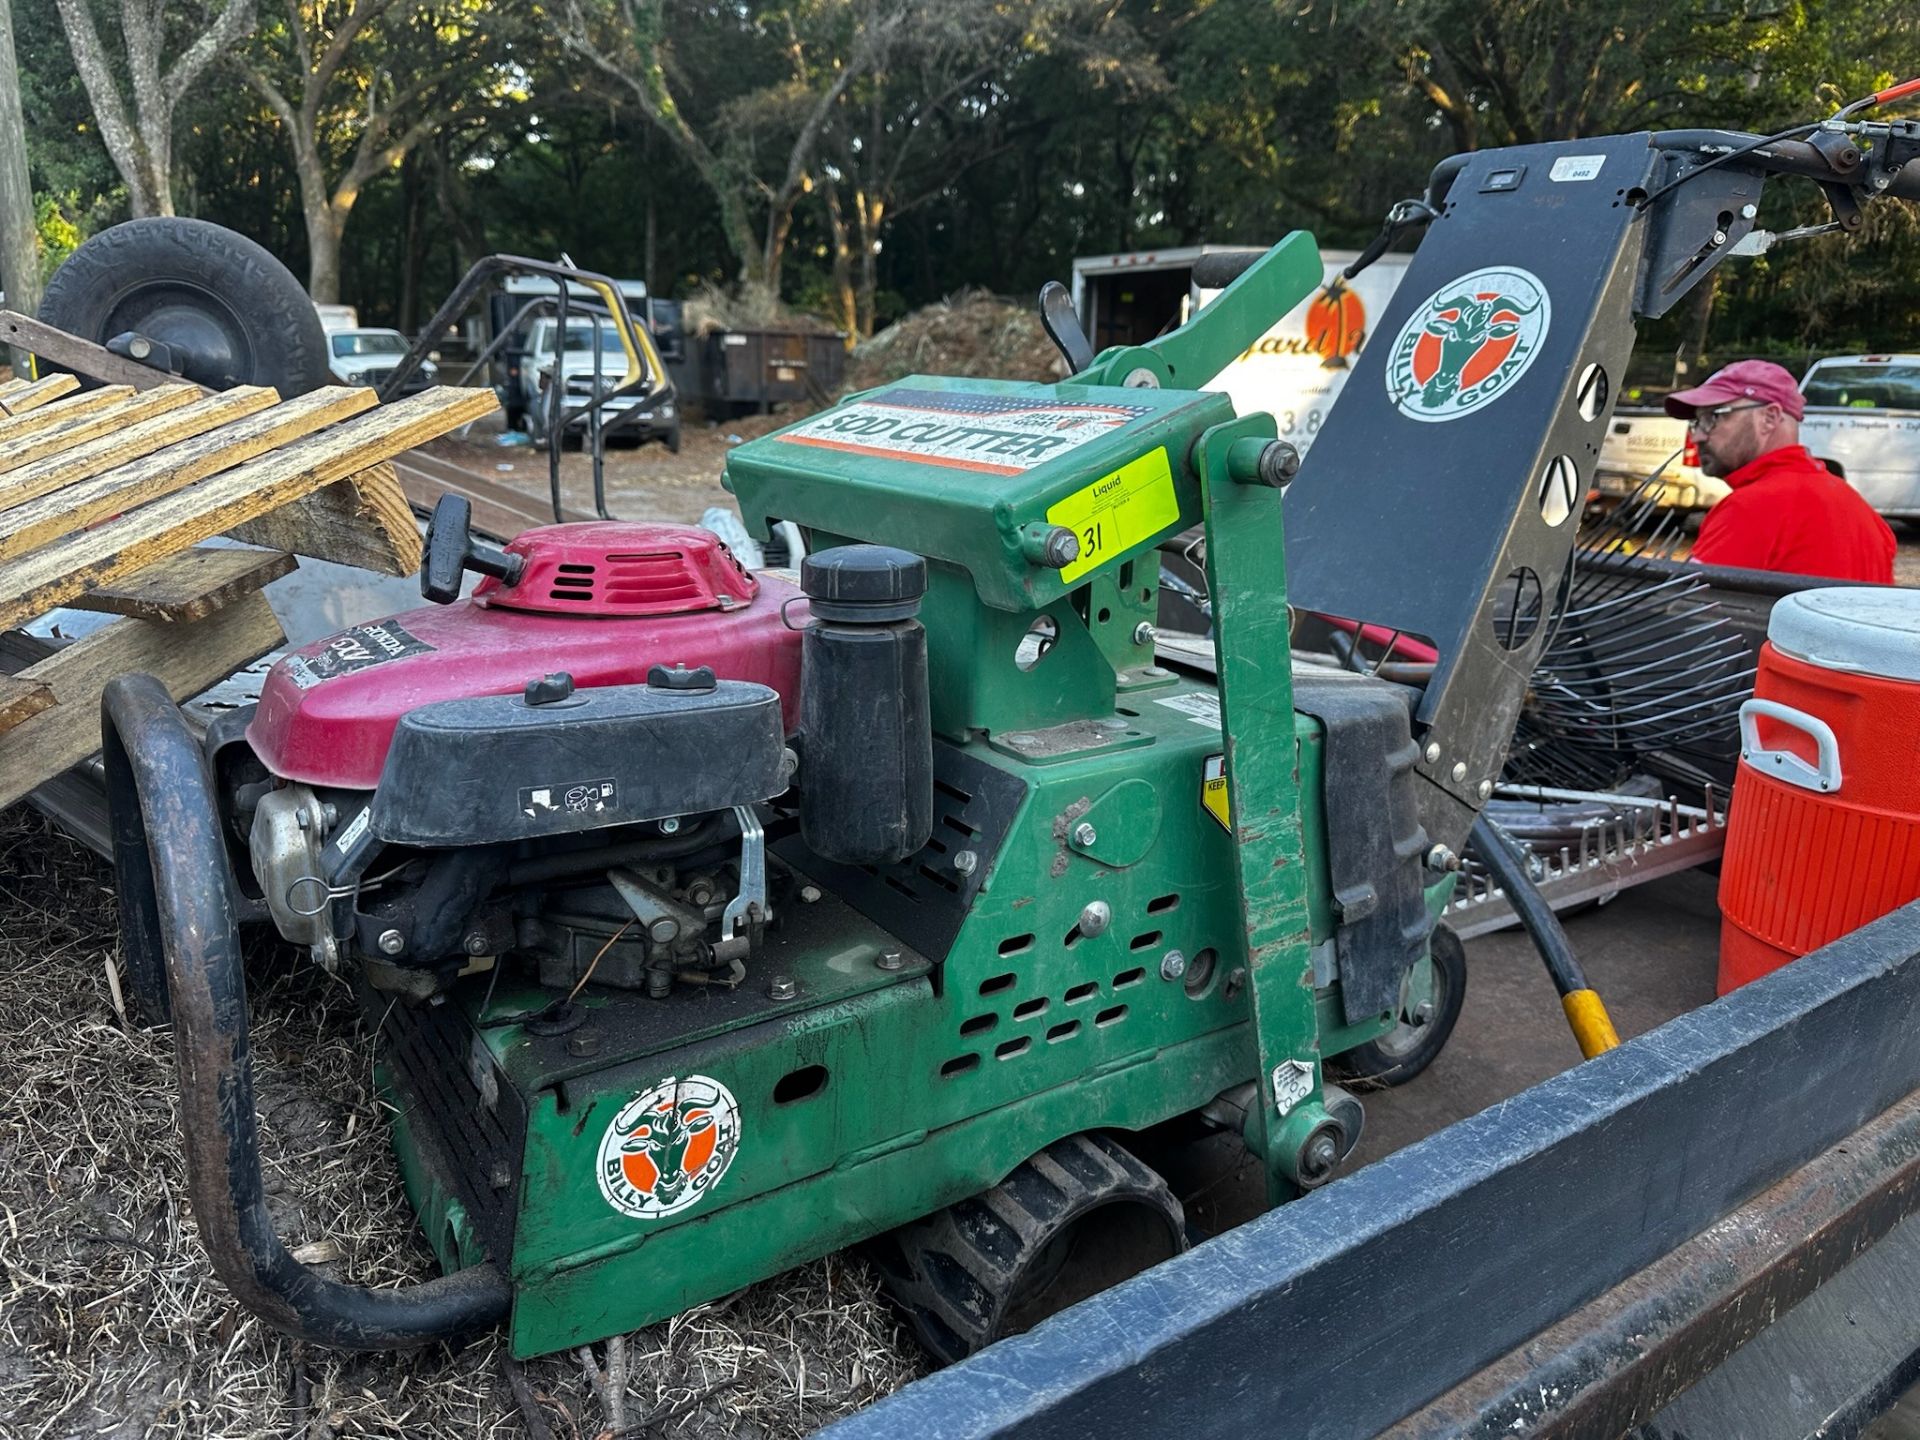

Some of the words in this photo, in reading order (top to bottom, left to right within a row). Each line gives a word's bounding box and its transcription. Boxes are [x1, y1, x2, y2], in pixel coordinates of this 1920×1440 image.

[1396, 332, 1422, 400] BILLY
[1456, 341, 1531, 407] GOAT
[816, 413, 901, 436] SOD
[889, 422, 1067, 459] CUTTER
[1092, 474, 1122, 498] Liquid
[1083, 522, 1102, 558] 31
[331, 637, 376, 661] GXV
[1208, 780, 1225, 792] KEEP
[606, 1158, 653, 1209] BILLY
[690, 1123, 737, 1192] GOAT
